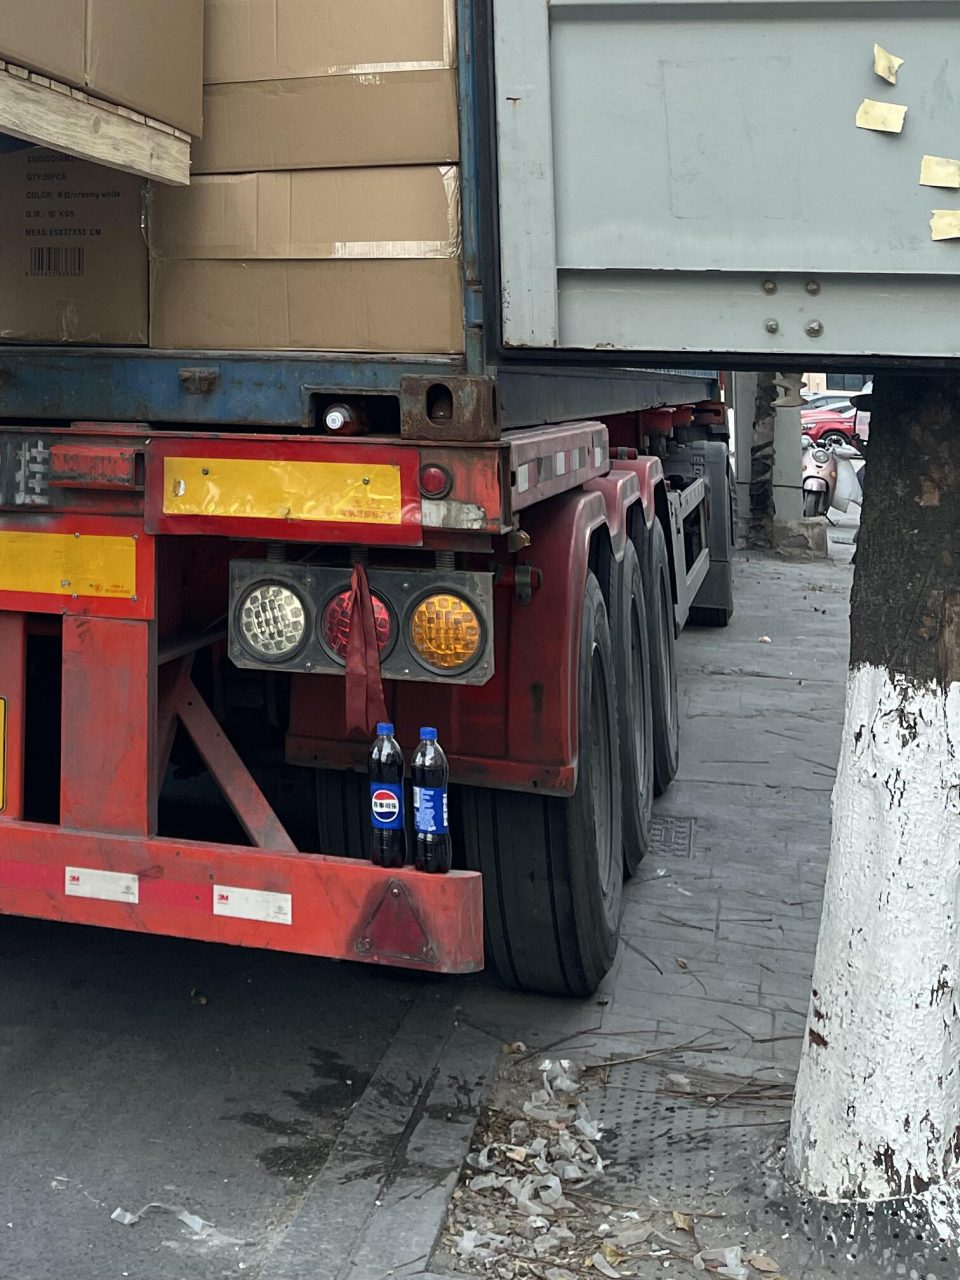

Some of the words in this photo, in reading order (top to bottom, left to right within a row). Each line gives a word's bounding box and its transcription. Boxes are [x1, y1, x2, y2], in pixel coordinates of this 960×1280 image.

[90, 228, 101, 236] CM
[69, 875, 80, 883] 3M
[217, 894, 229, 902] 3M
